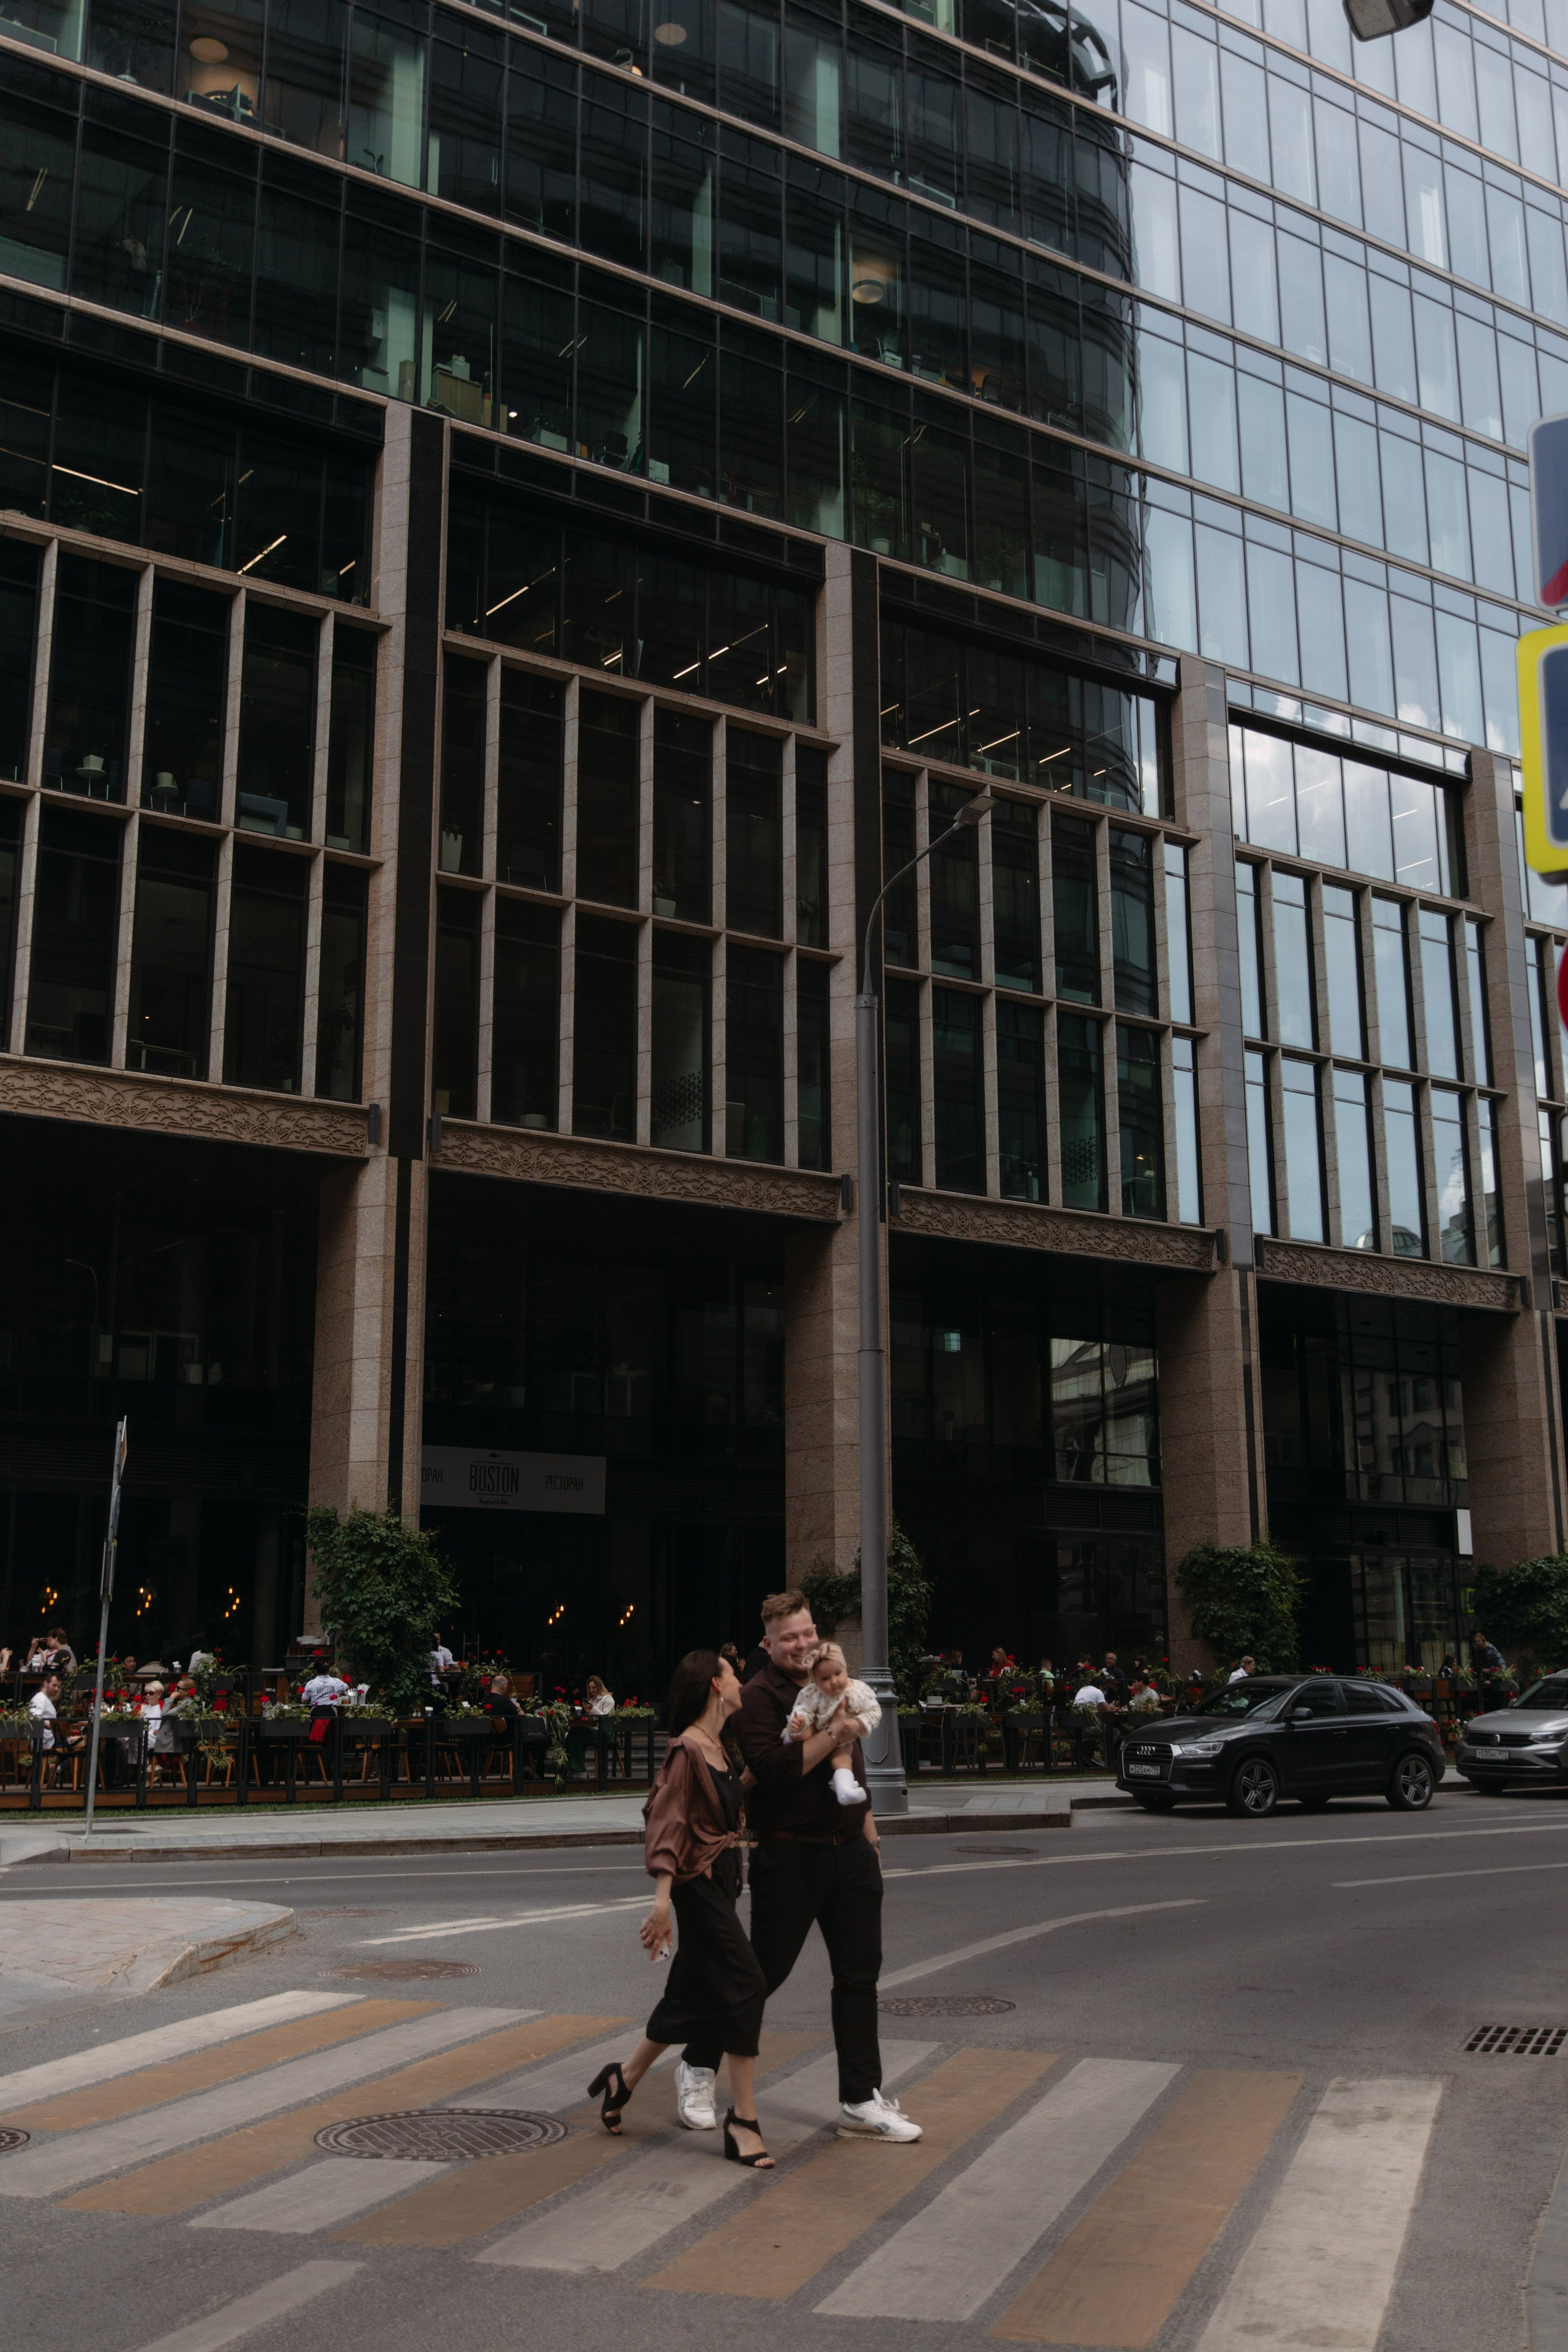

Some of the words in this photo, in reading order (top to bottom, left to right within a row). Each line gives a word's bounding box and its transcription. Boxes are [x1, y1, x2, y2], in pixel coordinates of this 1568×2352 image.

[421, 1467, 443, 1483] ОРАН
[469, 1464, 519, 1493] BOSTON
[545, 1475, 583, 1491] РЕСТОРАН
[316, 1685, 335, 1695] BOSTON
